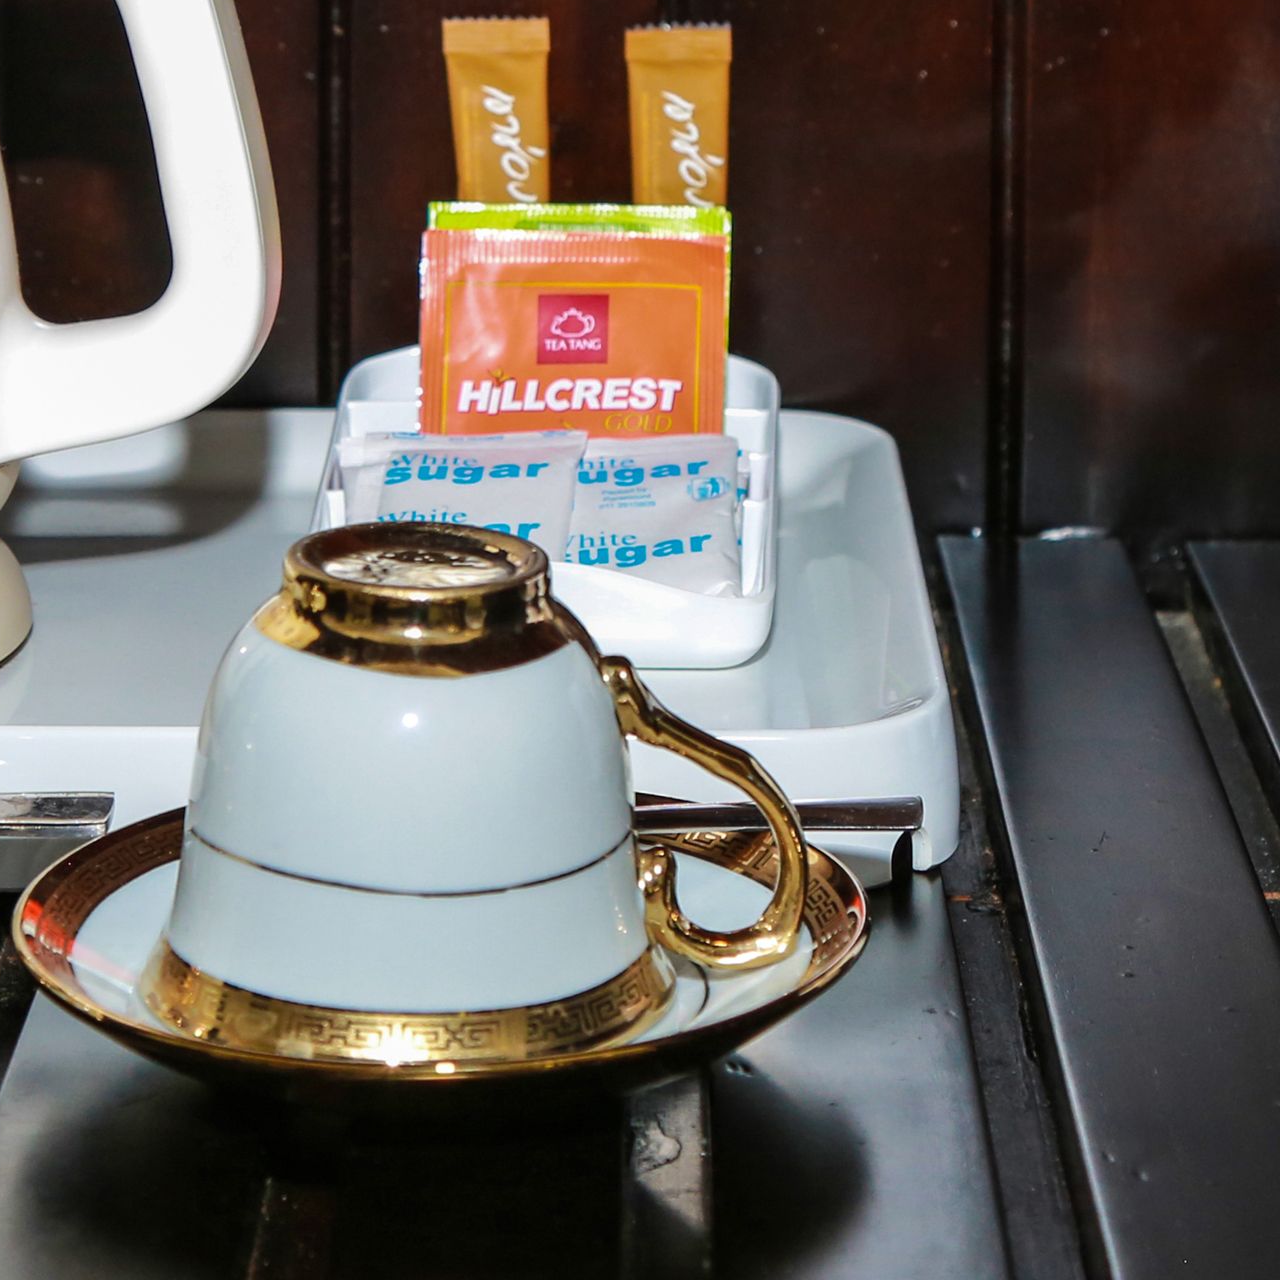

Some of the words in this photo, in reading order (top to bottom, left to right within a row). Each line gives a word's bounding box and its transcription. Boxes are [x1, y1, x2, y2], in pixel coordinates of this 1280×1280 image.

[544, 337, 568, 352] TEA
[568, 337, 602, 351] TANG
[604, 413, 673, 434] GOLD
[392, 453, 478, 466] White
[577, 457, 635, 471] hite
[384, 462, 550, 485] sugar
[578, 460, 708, 487] ugar
[566, 532, 637, 548] hite
